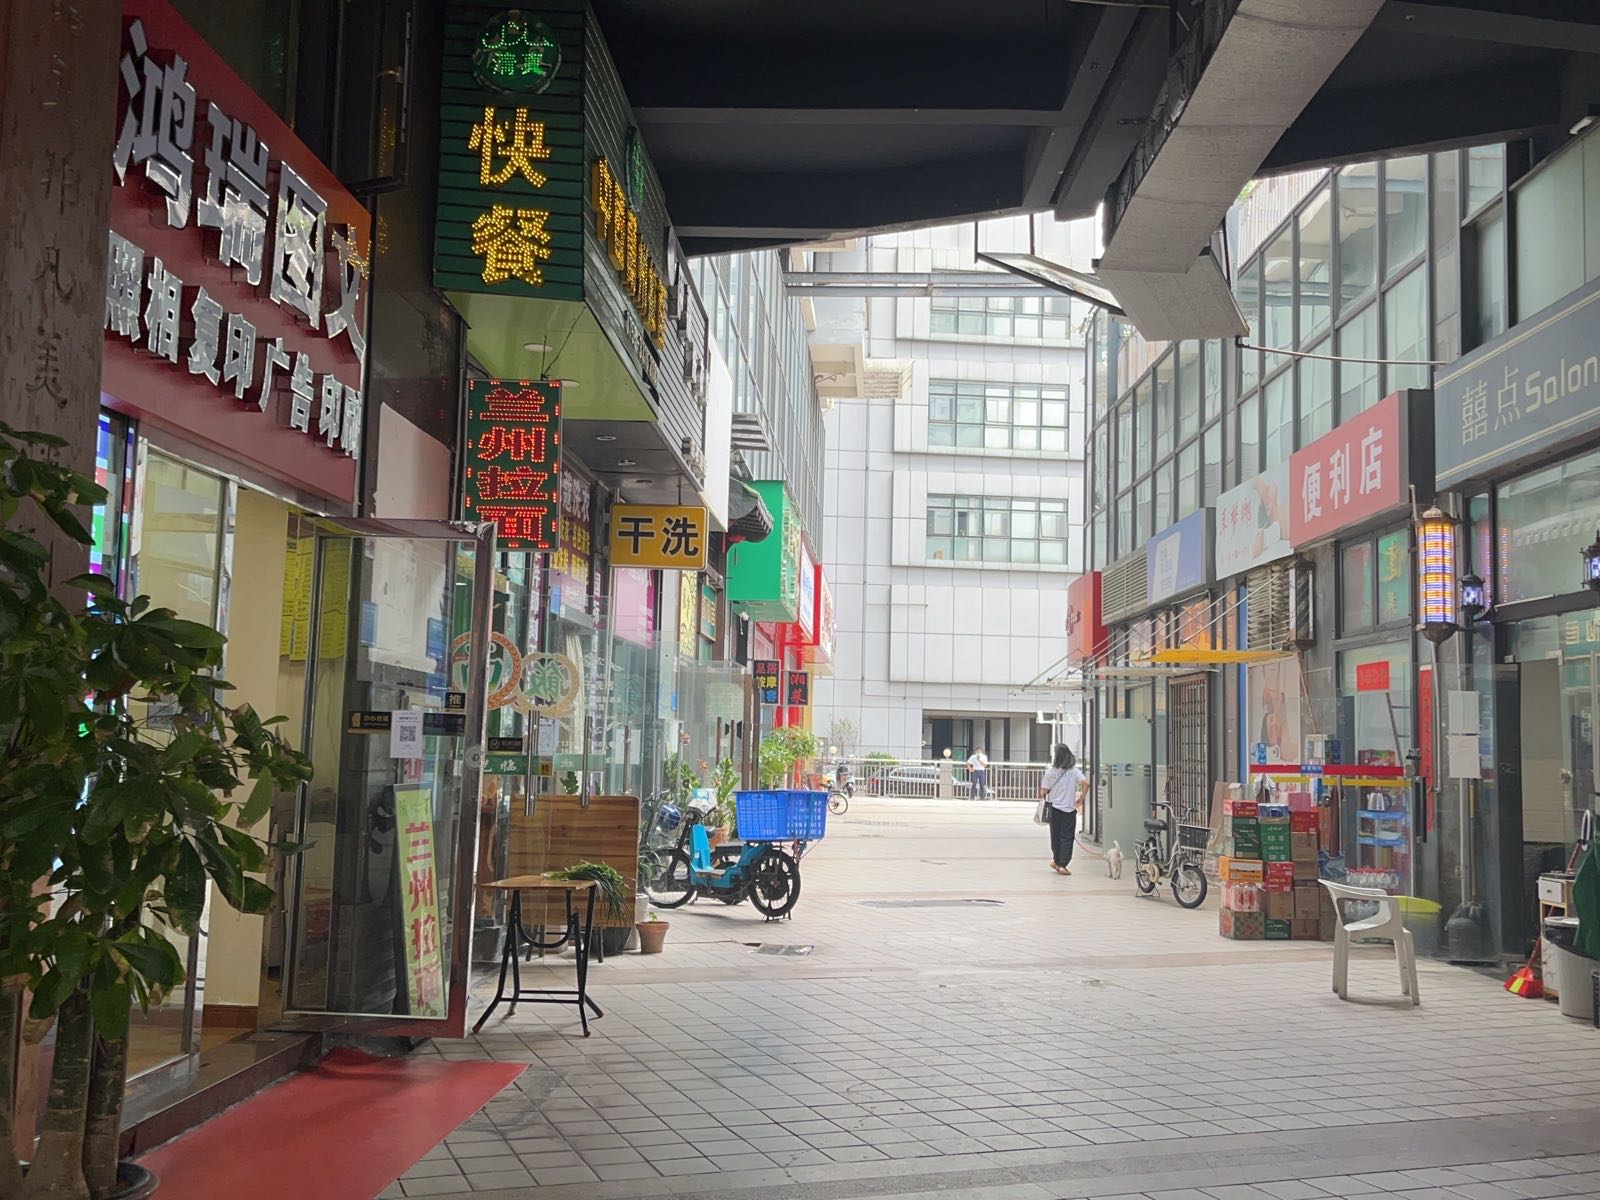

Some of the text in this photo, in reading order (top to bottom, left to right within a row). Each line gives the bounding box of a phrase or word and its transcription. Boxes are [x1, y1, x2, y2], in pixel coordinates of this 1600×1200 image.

[113, 18, 371, 360] 鸿瑞图文
[468, 105, 552, 285] 快餐
[104, 229, 363, 461] 照相复印广告印刷
[475, 387, 550, 542] 兰州拉面
[617, 515, 700, 557] 干洗
[1302, 426, 1383, 523] 便利店
